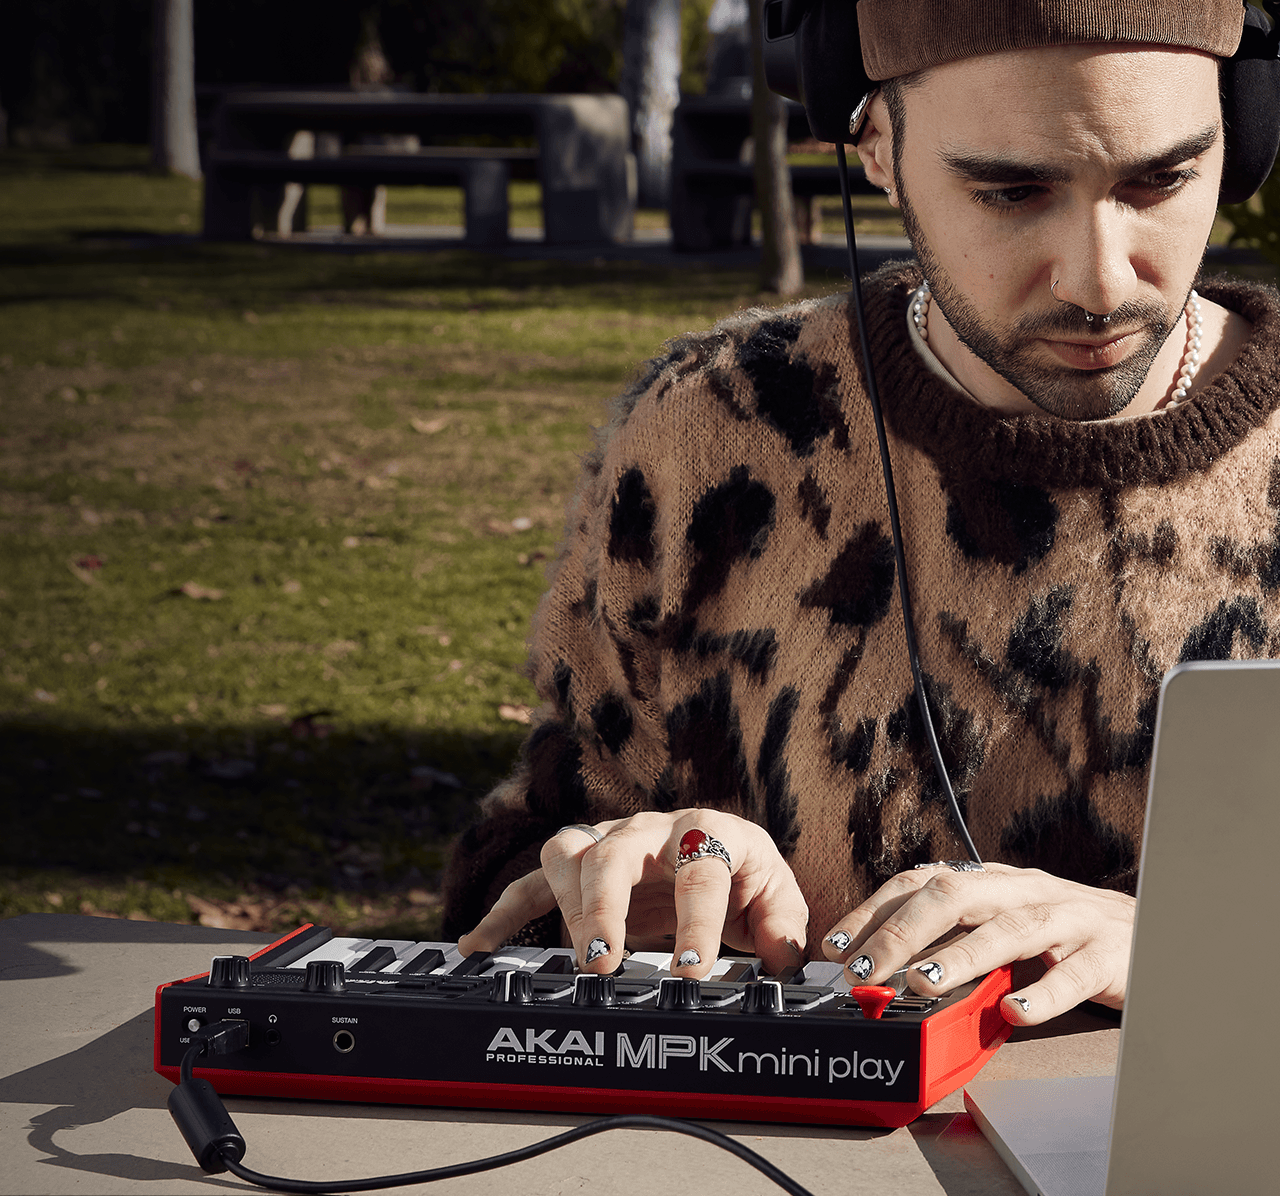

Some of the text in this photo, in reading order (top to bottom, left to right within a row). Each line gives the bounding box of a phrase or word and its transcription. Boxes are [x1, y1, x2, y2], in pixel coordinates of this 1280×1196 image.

[183, 1005, 207, 1014] POWER
[227, 1007, 242, 1015] USB
[331, 1016, 359, 1024] SUSTAIN
[486, 1027, 605, 1056] AKAI
[486, 1052, 605, 1067] PROFESSIONAL
[616, 1032, 905, 1086] MPK mini play
